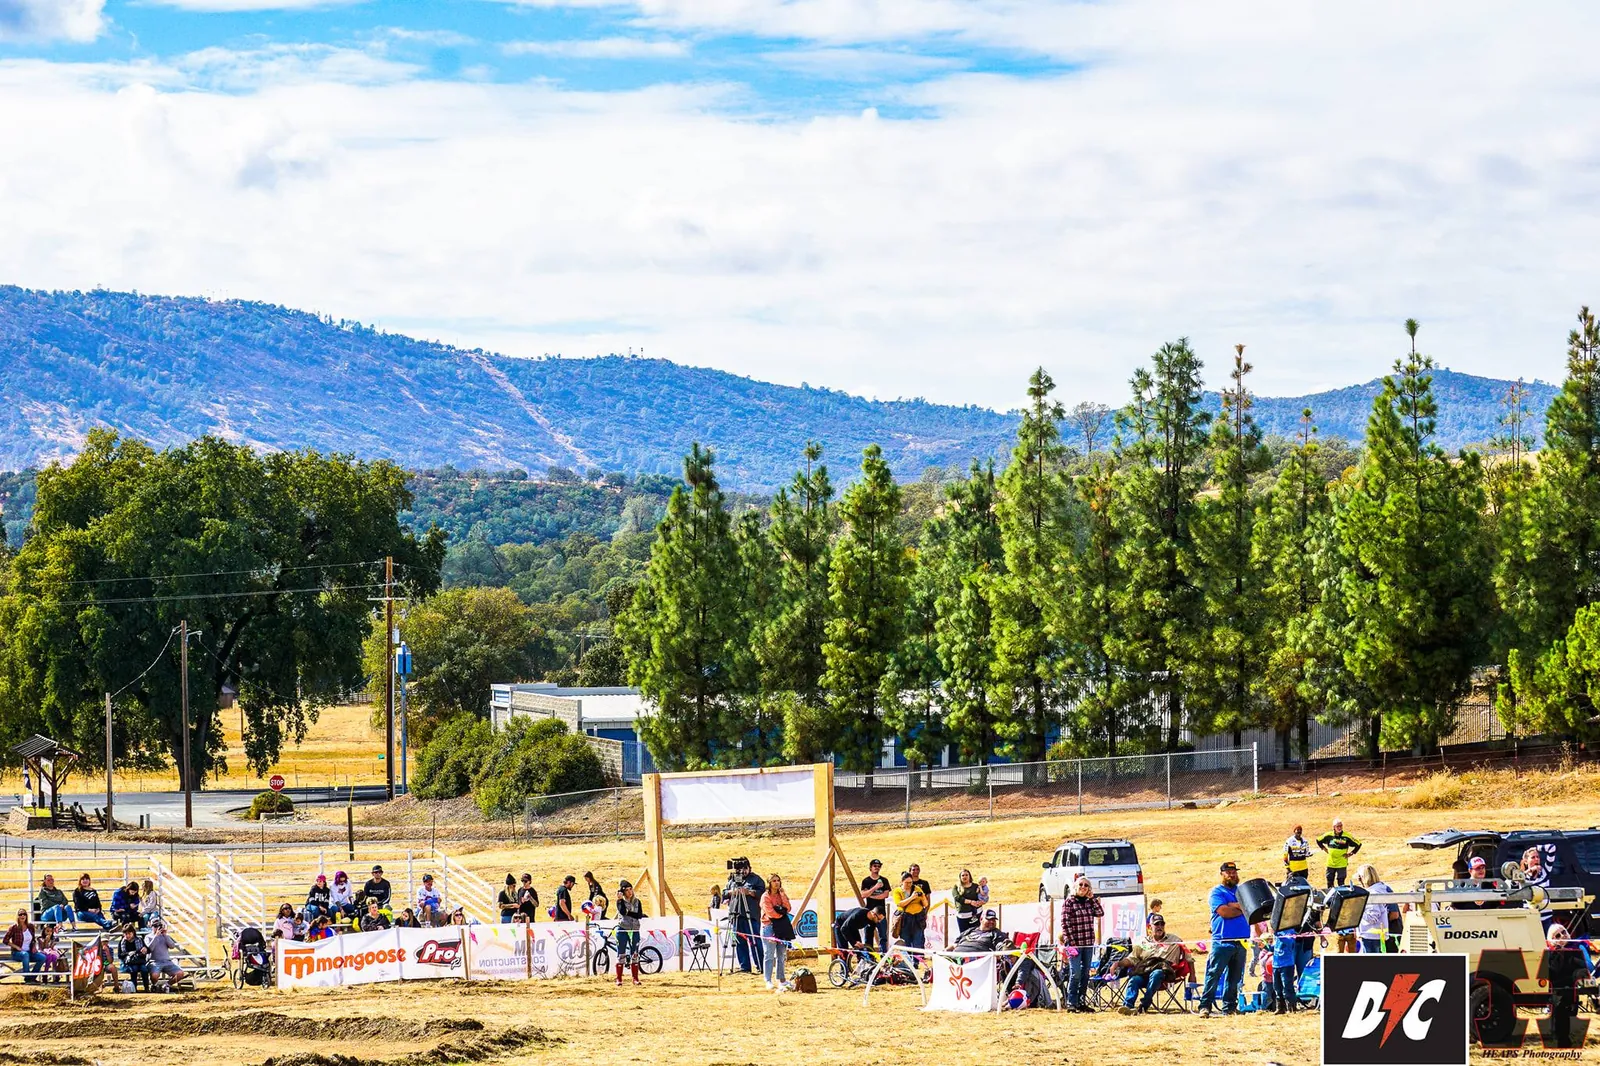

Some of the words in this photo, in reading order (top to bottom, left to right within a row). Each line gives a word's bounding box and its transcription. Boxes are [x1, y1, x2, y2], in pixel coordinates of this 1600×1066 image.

[1435, 916, 1451, 925] LSC
[1444, 930, 1498, 940] DOOSAN
[316, 947, 407, 972] mongoose
